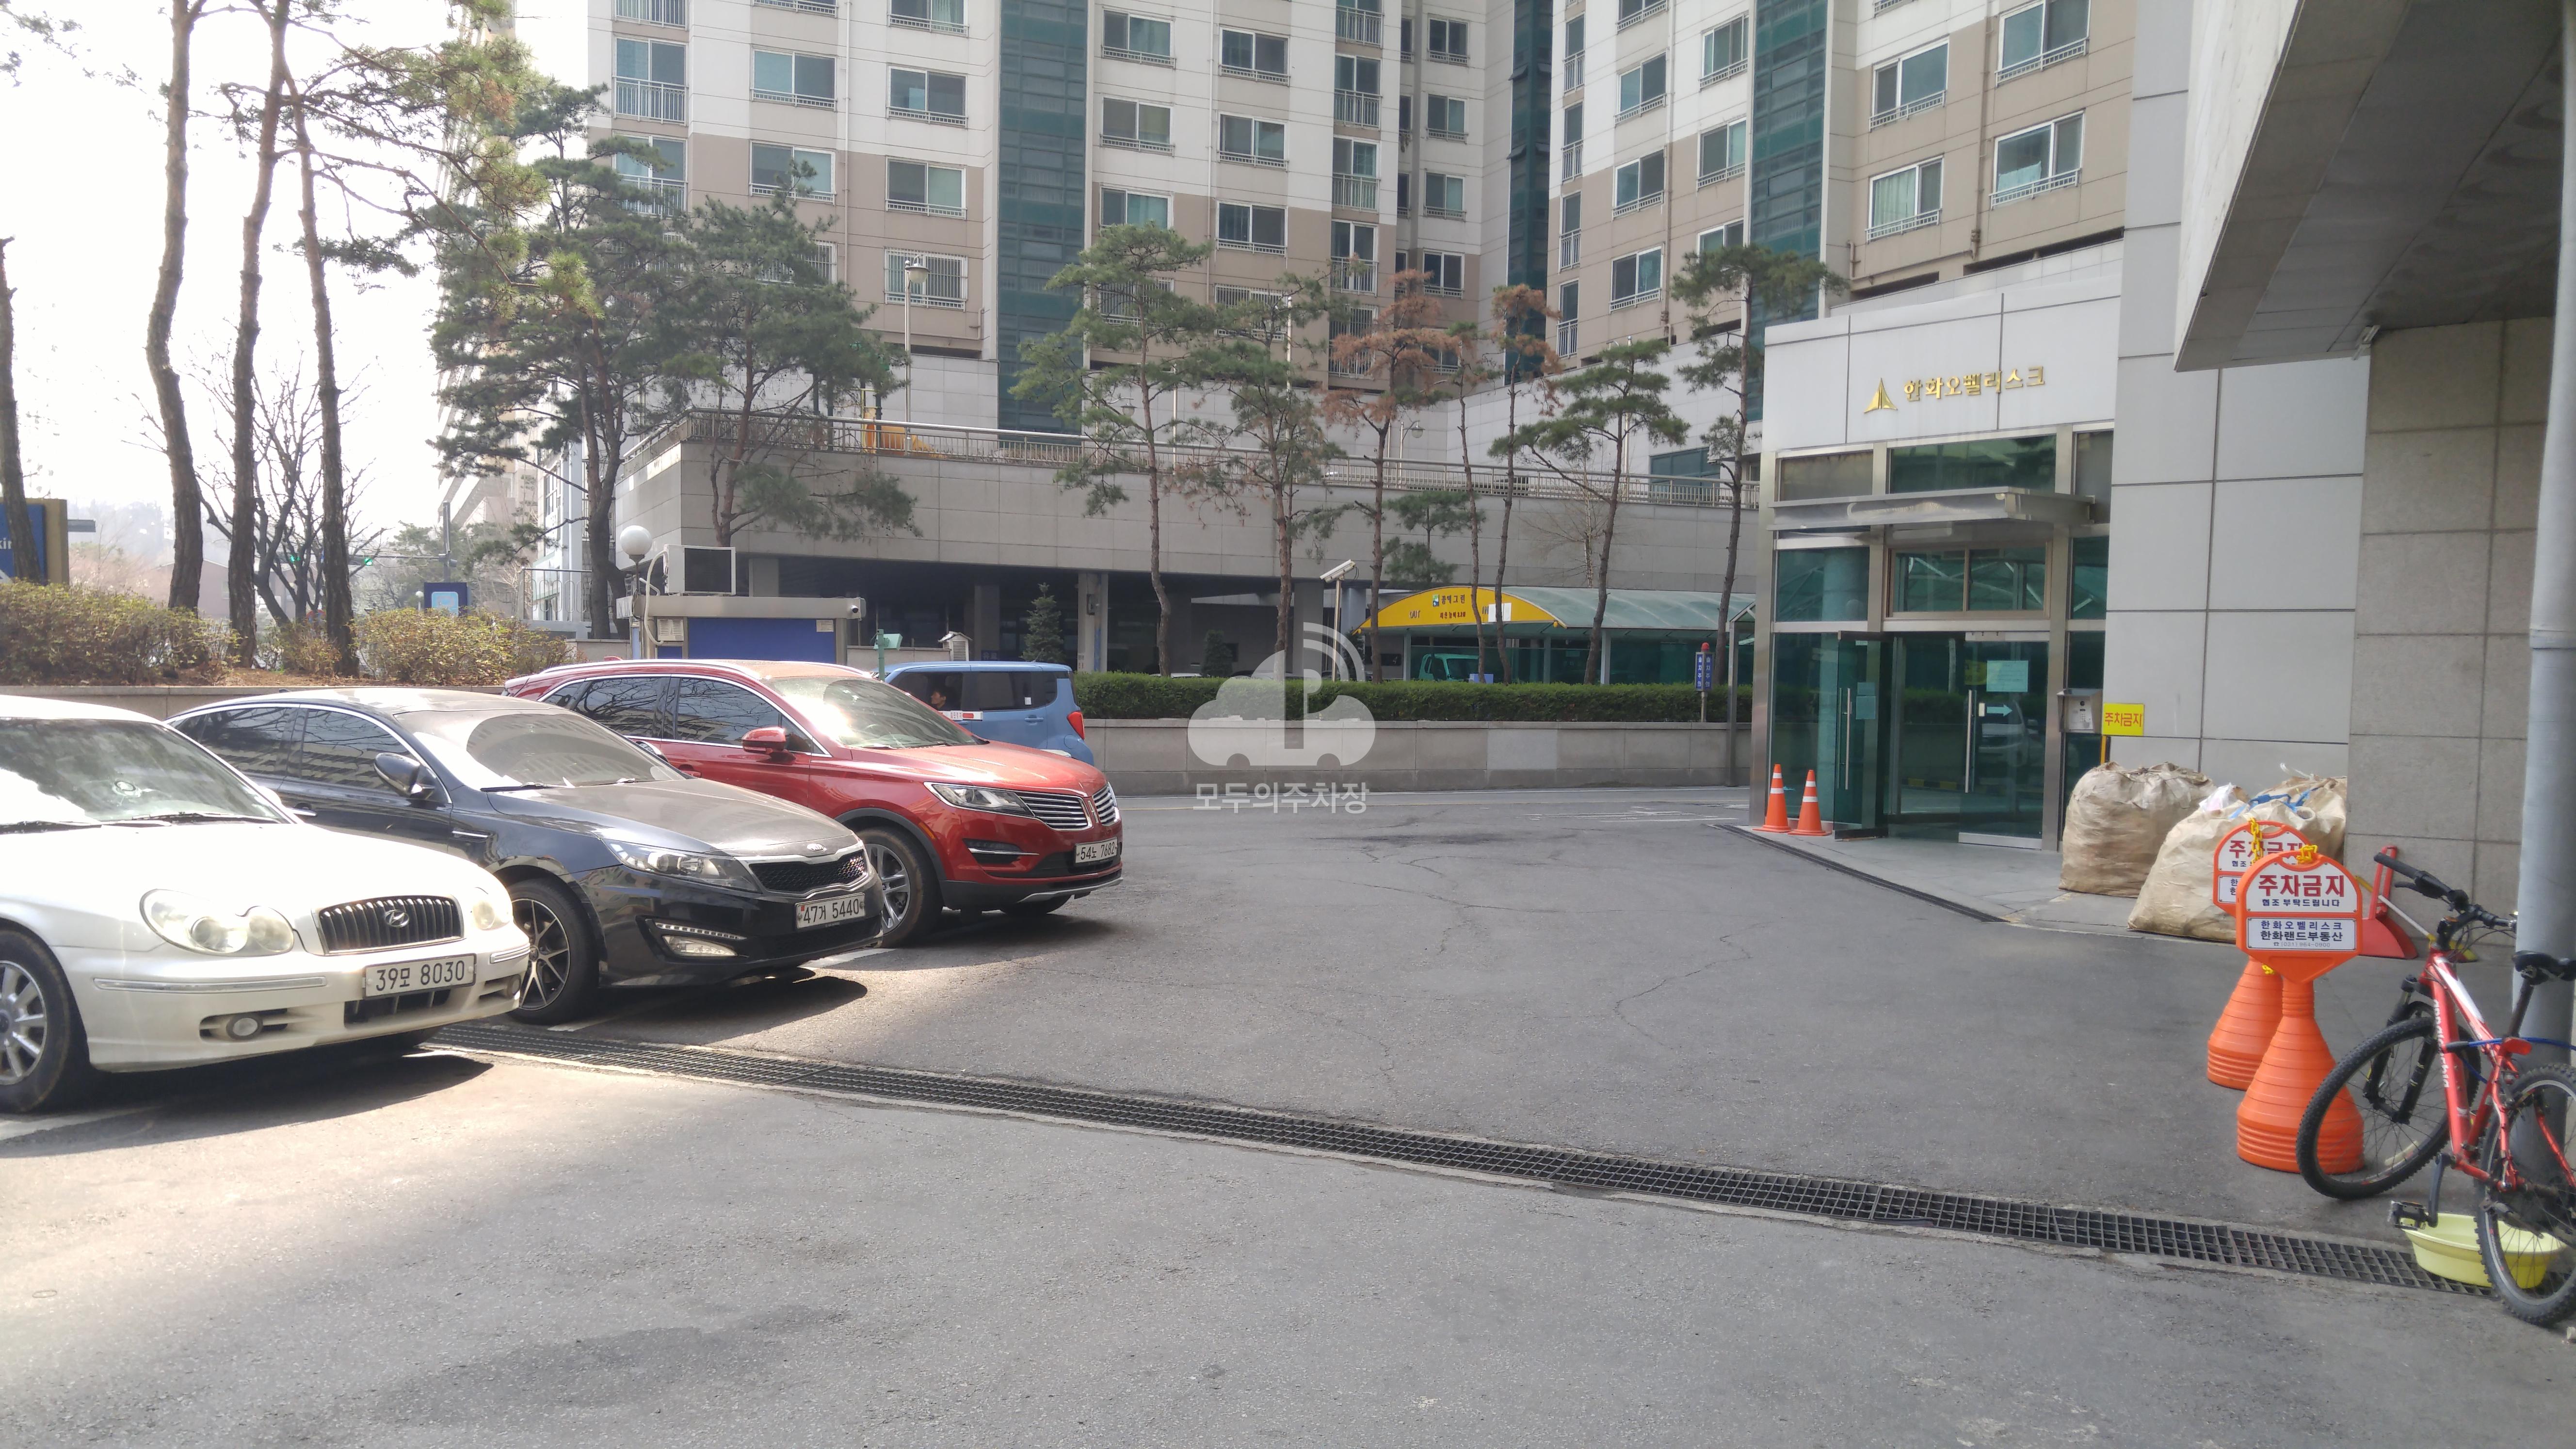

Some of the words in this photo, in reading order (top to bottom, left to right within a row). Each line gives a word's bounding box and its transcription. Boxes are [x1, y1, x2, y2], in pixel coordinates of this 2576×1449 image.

[1904, 366, 2045, 402] 한화오벨리스크
[1409, 610, 1421, 618] OUT
[2105, 712, 2142, 727] 주차금지
[1080, 846, 1097, 860] 54노
[1101, 841, 1115, 857] 7682
[2258, 875, 2345, 897] 주차금지
[803, 905, 826, 924] 47거
[832, 898, 859, 919] 5440
[2260, 931, 2343, 942] 한화랜드부동산
[376, 967, 410, 991] 39모
[420, 960, 465, 985] 8030
